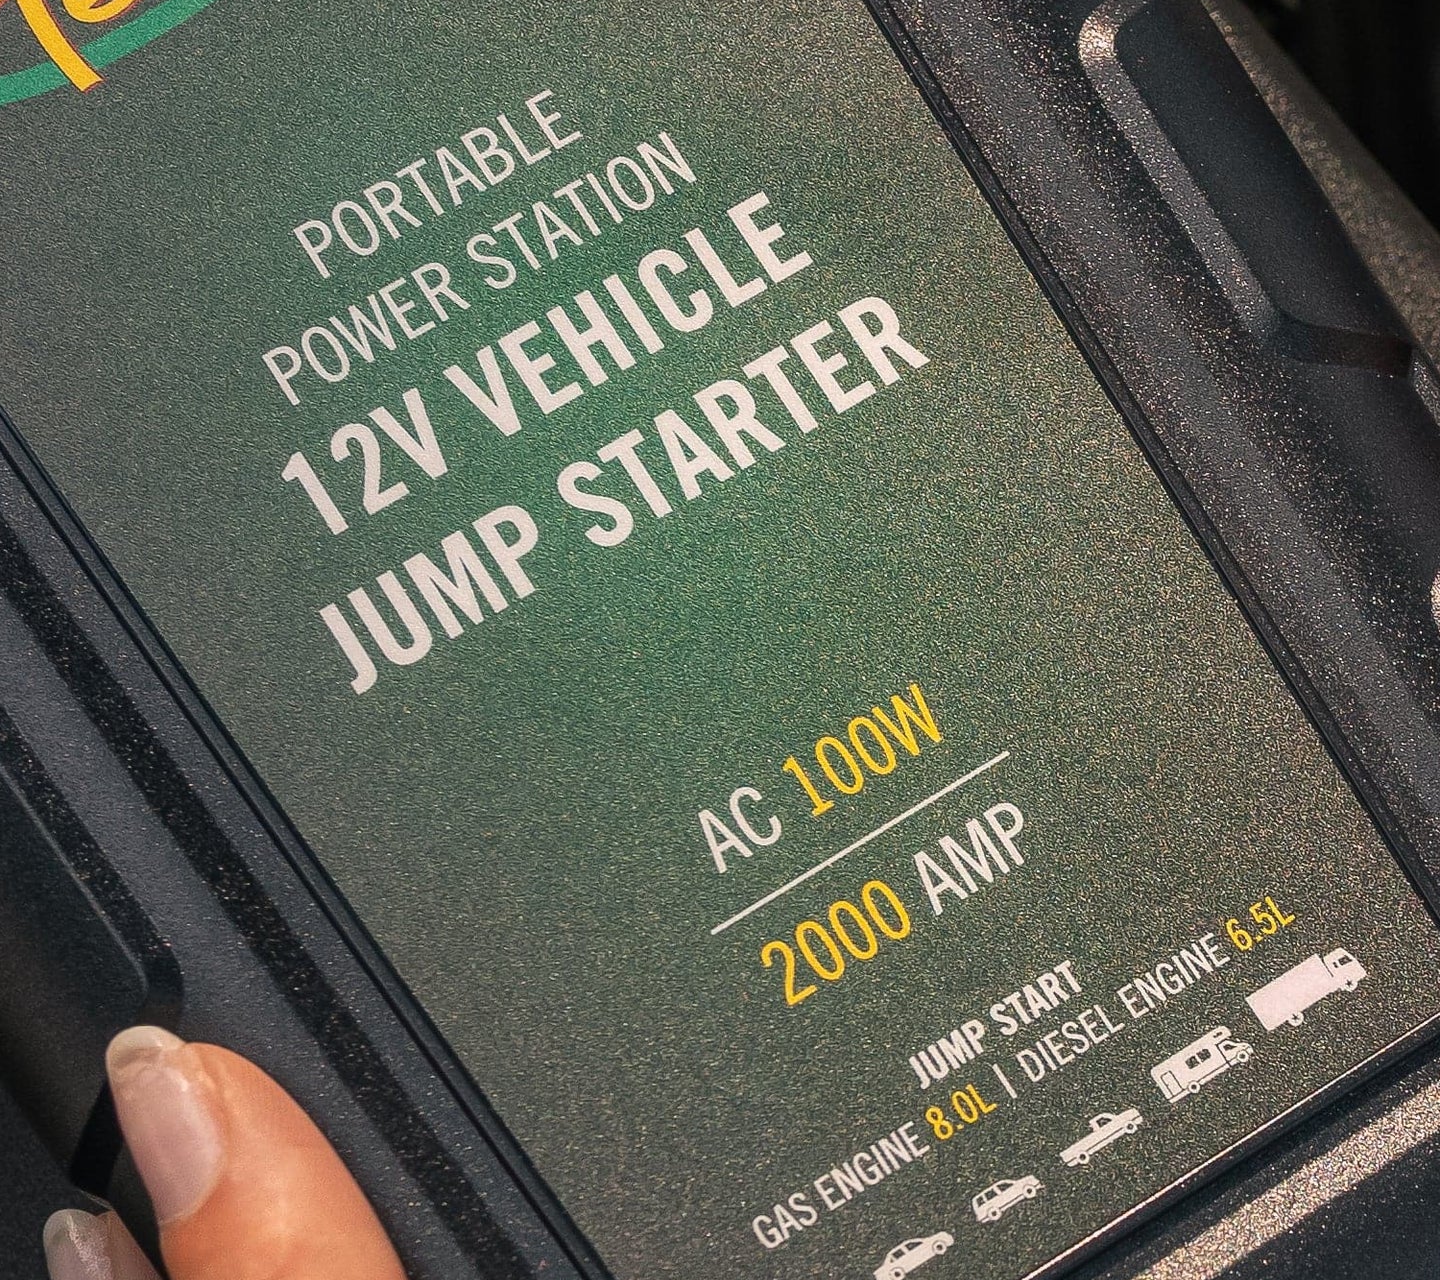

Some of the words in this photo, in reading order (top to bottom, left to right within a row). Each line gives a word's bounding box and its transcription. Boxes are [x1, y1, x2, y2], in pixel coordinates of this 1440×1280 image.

[261, 261, 471, 407] POWER
[466, 131, 697, 291] STATION
[292, 89, 582, 279] PORTABLE
[280, 387, 450, 536] 12V
[443, 191, 814, 437] VEHICLE
[318, 504, 540, 695] JUMP
[556, 295, 932, 548] STARTER
[696, 786, 782, 874] AC
[781, 682, 945, 818] 100W
[761, 879, 912, 1006] 2000
[911, 801, 1025, 916] AMP
[752, 1192, 819, 1250] GAS
[813, 1121, 931, 1211] ENGINE
[924, 1084, 998, 1141] 8.0L
[1016, 1004, 1126, 1084] DIESEL
[1116, 932, 1232, 1019] ENGINE
[1224, 895, 1297, 952] 6.5L
[908, 1019, 986, 1090] JUMP
[988, 960, 1083, 1036] START
